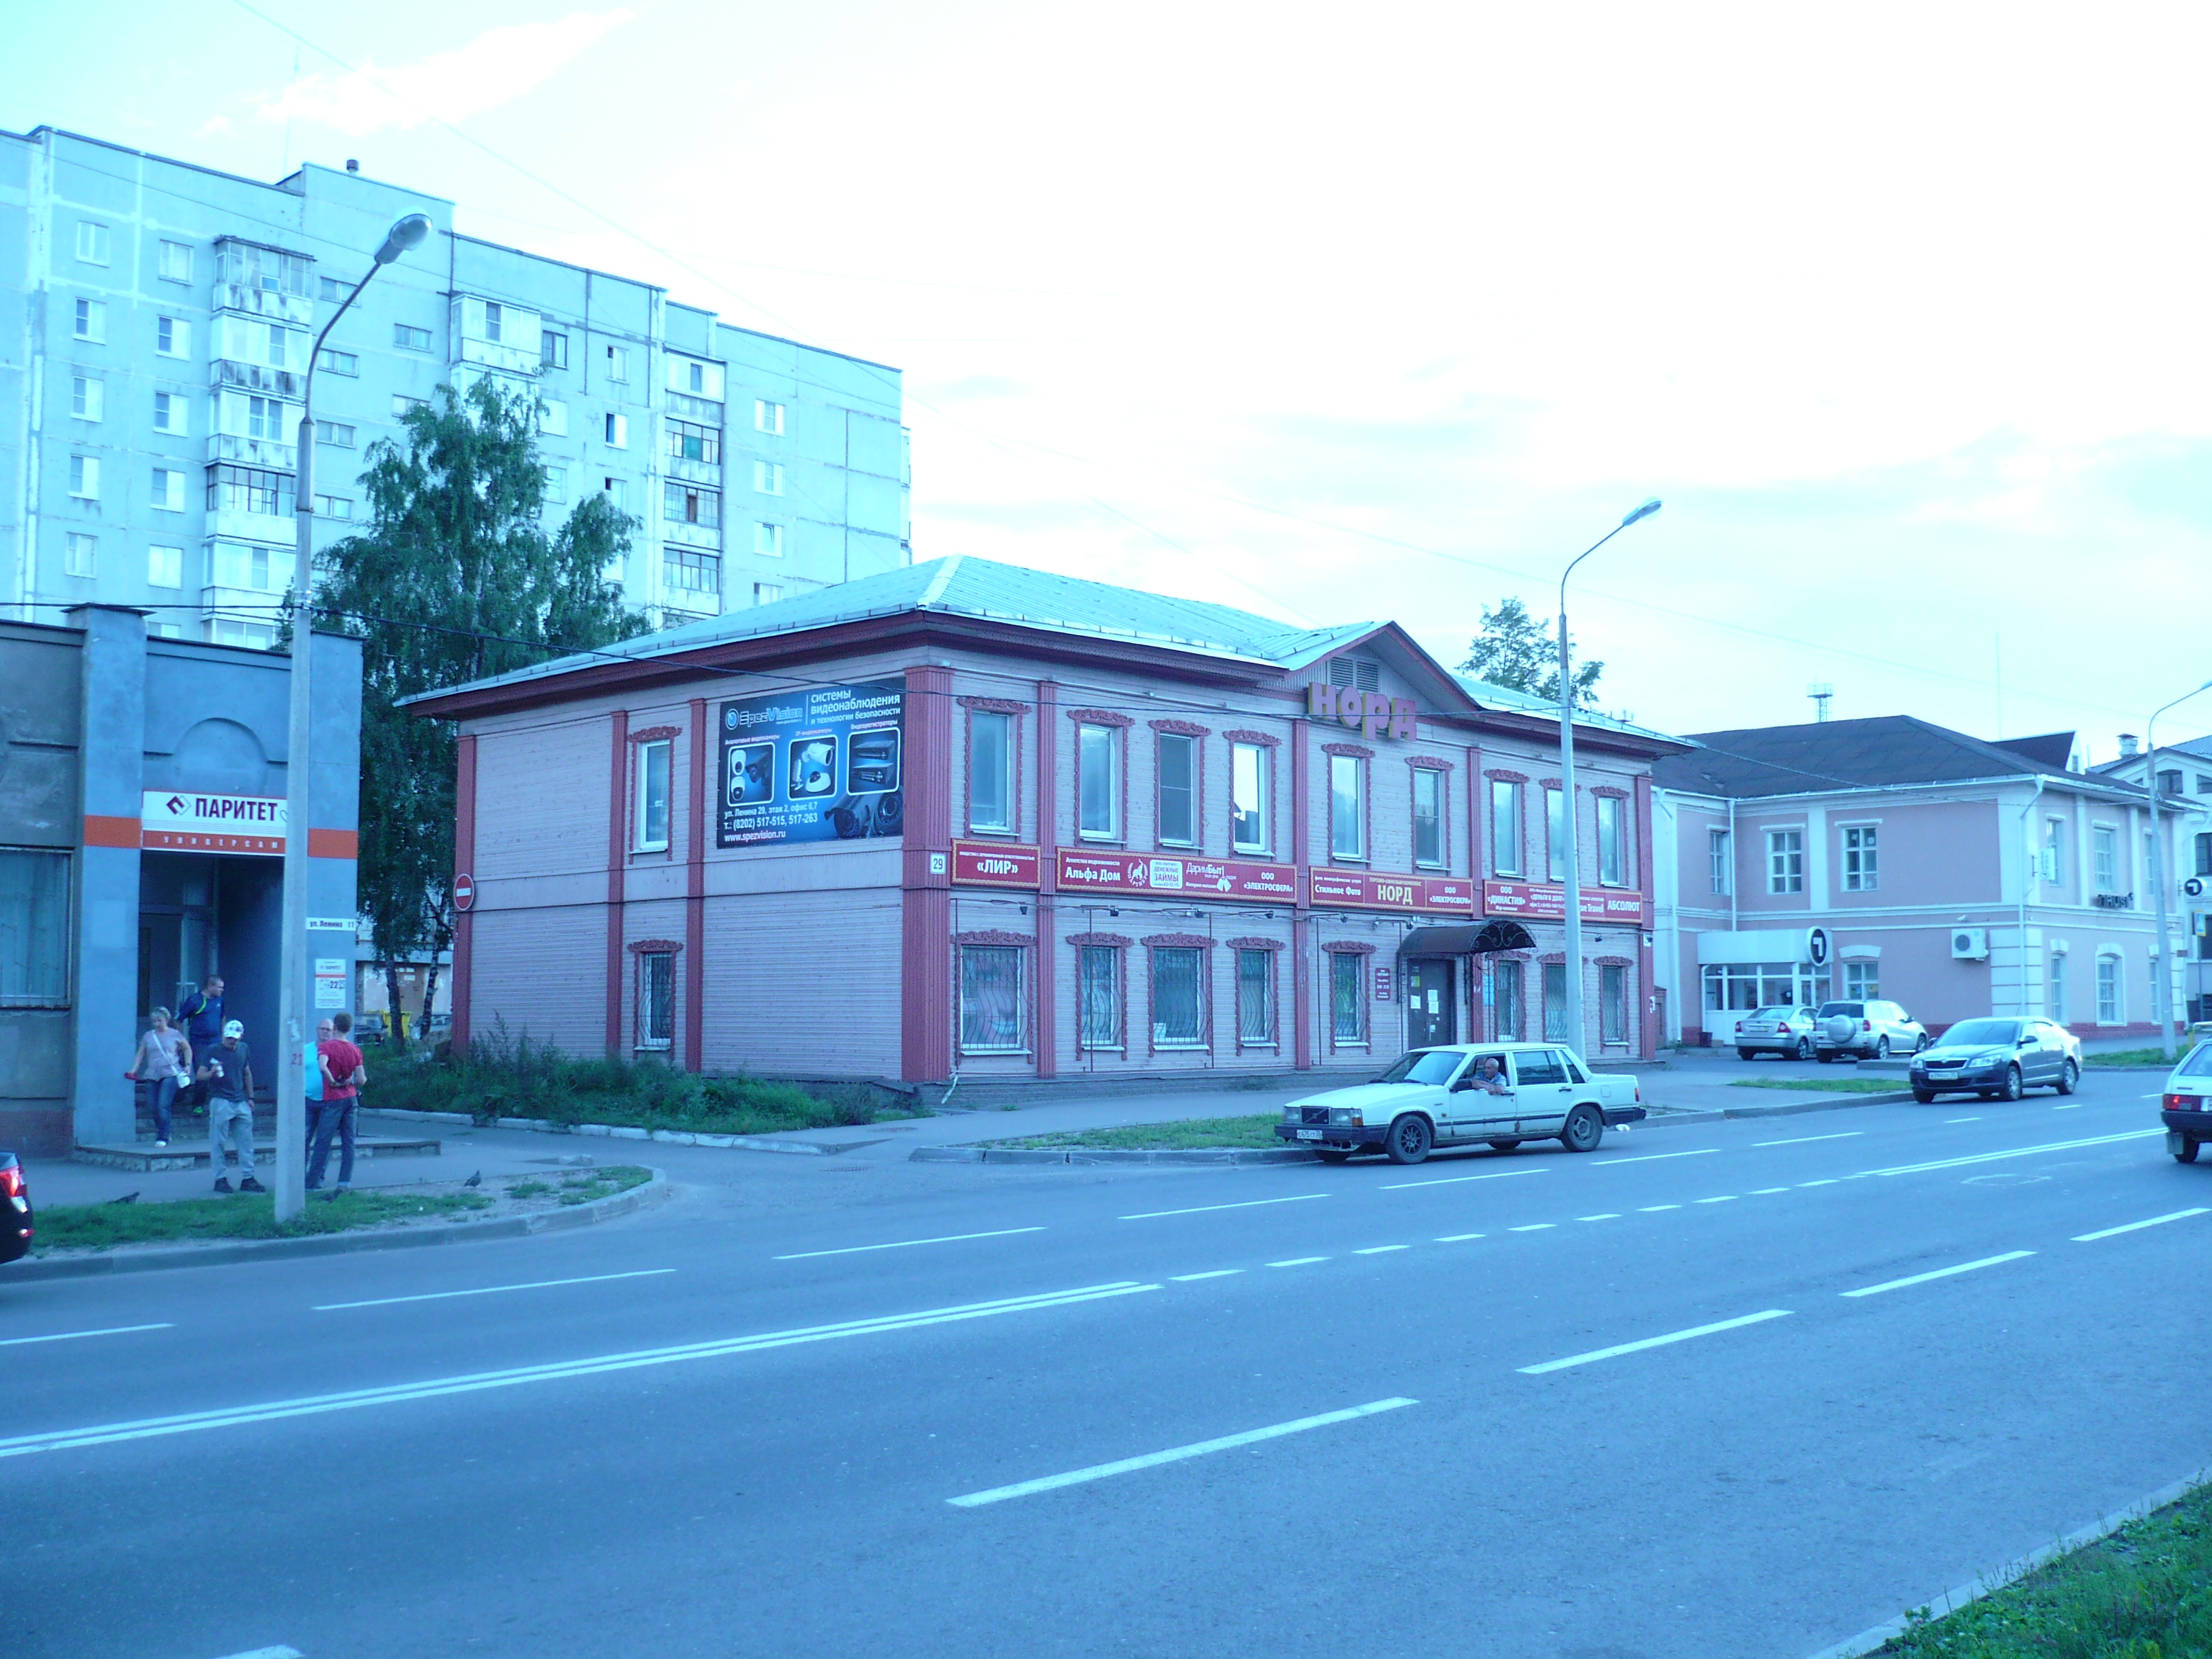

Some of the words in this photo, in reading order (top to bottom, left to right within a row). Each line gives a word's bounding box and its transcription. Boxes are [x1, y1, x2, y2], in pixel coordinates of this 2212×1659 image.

[811, 690, 851, 703] системы
[811, 694, 900, 714] видеонаблюдения
[817, 714, 854, 724] технологии
[855, 707, 900, 719] безопасности
[195, 798, 278, 822] ПАРИТЕТ
[724, 811, 734, 819] ул.
[734, 808, 757, 817] Ленина
[791, 804, 807, 812] офис
[733, 818, 755, 831] (8202)
[756, 815, 787, 827] 517-515,
[789, 812, 818, 824] 517-263
[724, 830, 786, 842] www.spezvision.ru
[933, 858, 943, 869] 29
[977, 860, 1018, 874] «ЛИР»
[1066, 867, 1097, 881] Альфа
[1099, 869, 1120, 882] Дом
[1154, 873, 1179, 882] ЗАЙМЫ
[1244, 881, 1293, 892] «ЭЛЕКТРОСФЕРА»
[1315, 884, 1344, 895] Стильное
[1346, 886, 1361, 896] Фото
[1501, 886, 1512, 894] ООО
[1377, 884, 1413, 905] НОРД
[1488, 894, 1526, 906] «ДИНАСТИЯ»
[1607, 900, 1640, 912] АБСОЛЮТ
